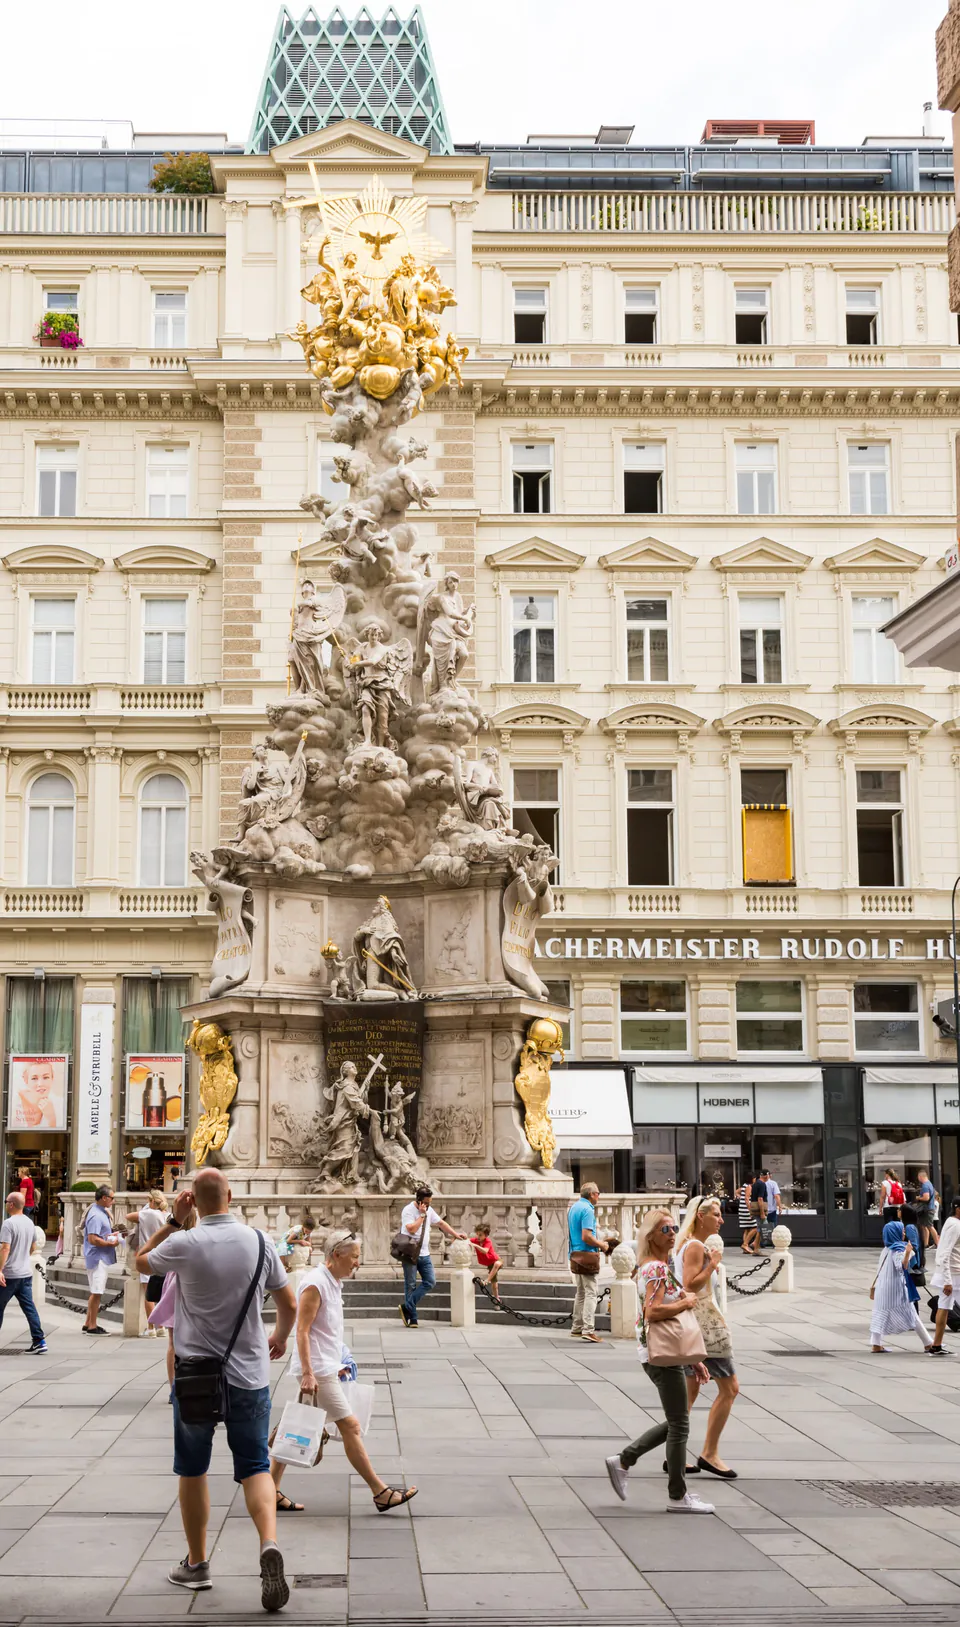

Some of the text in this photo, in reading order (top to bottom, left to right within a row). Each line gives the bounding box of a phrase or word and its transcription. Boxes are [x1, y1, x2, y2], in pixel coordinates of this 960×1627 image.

[780, 937, 904, 960] RUDOLF
[365, 1030, 383, 1040] DEO
[92, 1032, 102, 1082] STRUBELL
